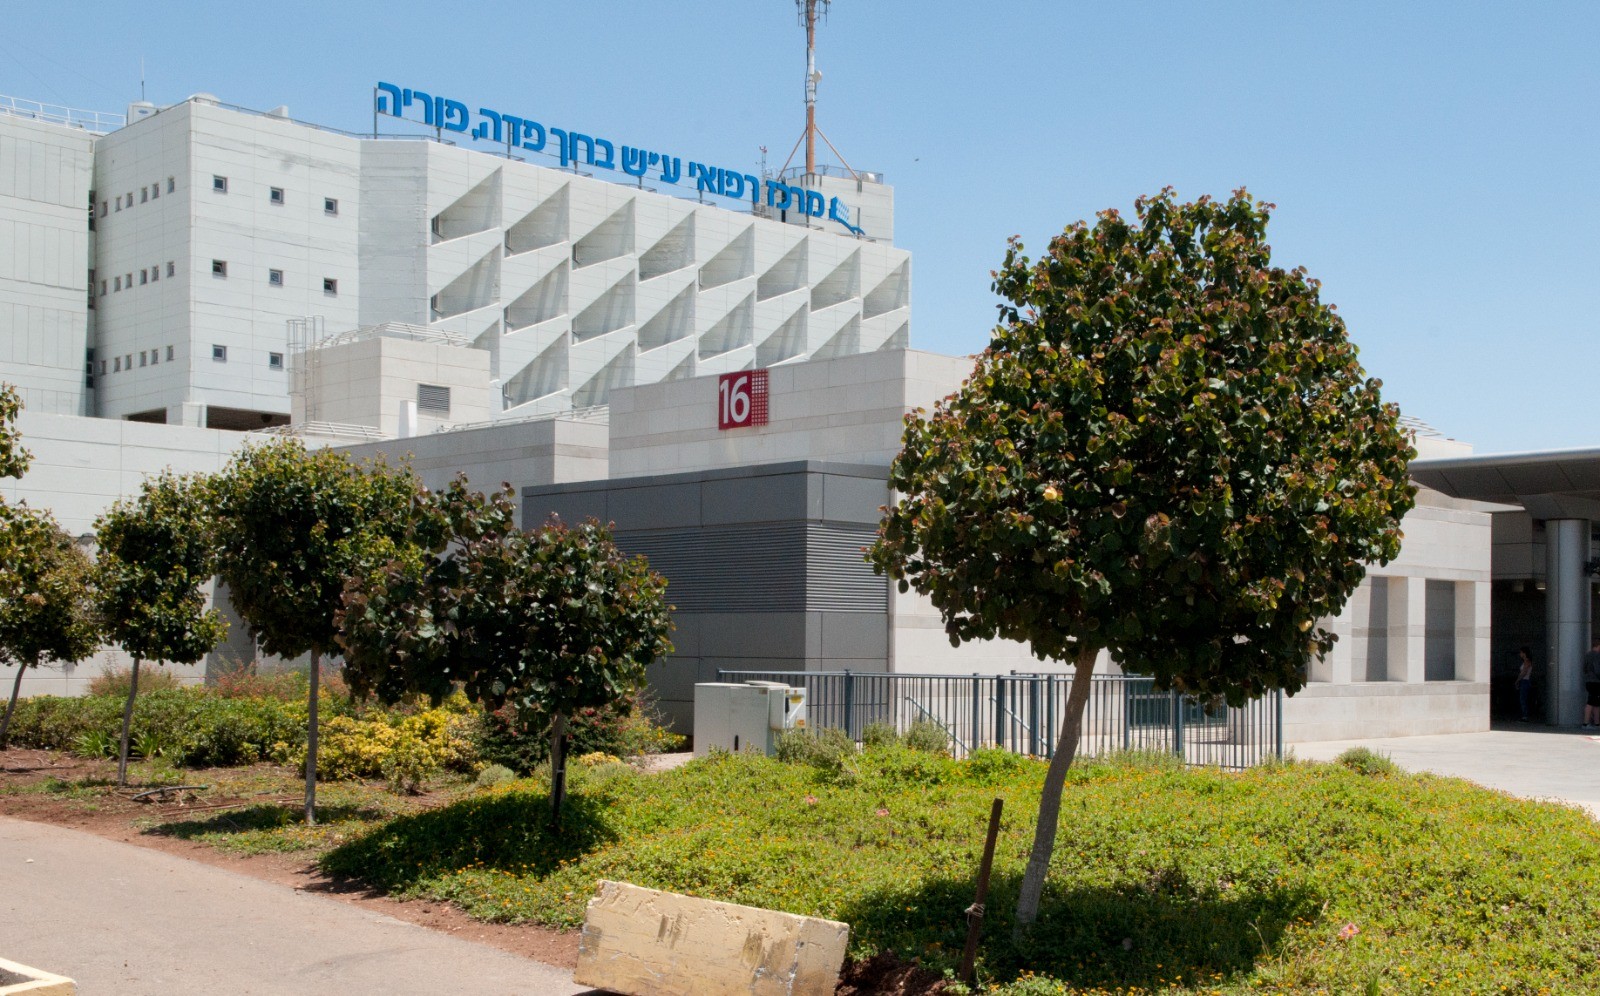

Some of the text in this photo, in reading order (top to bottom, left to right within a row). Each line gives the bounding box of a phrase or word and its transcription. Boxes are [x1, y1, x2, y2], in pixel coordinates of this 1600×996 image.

[377, 81, 470, 133] פוריה
[472, 108, 547, 151] פדה,
[550, 127, 615, 170] ברוך
[689, 162, 760, 203] רפואי
[766, 180, 825, 217] מרכז
[720, 376, 750, 424] 16
